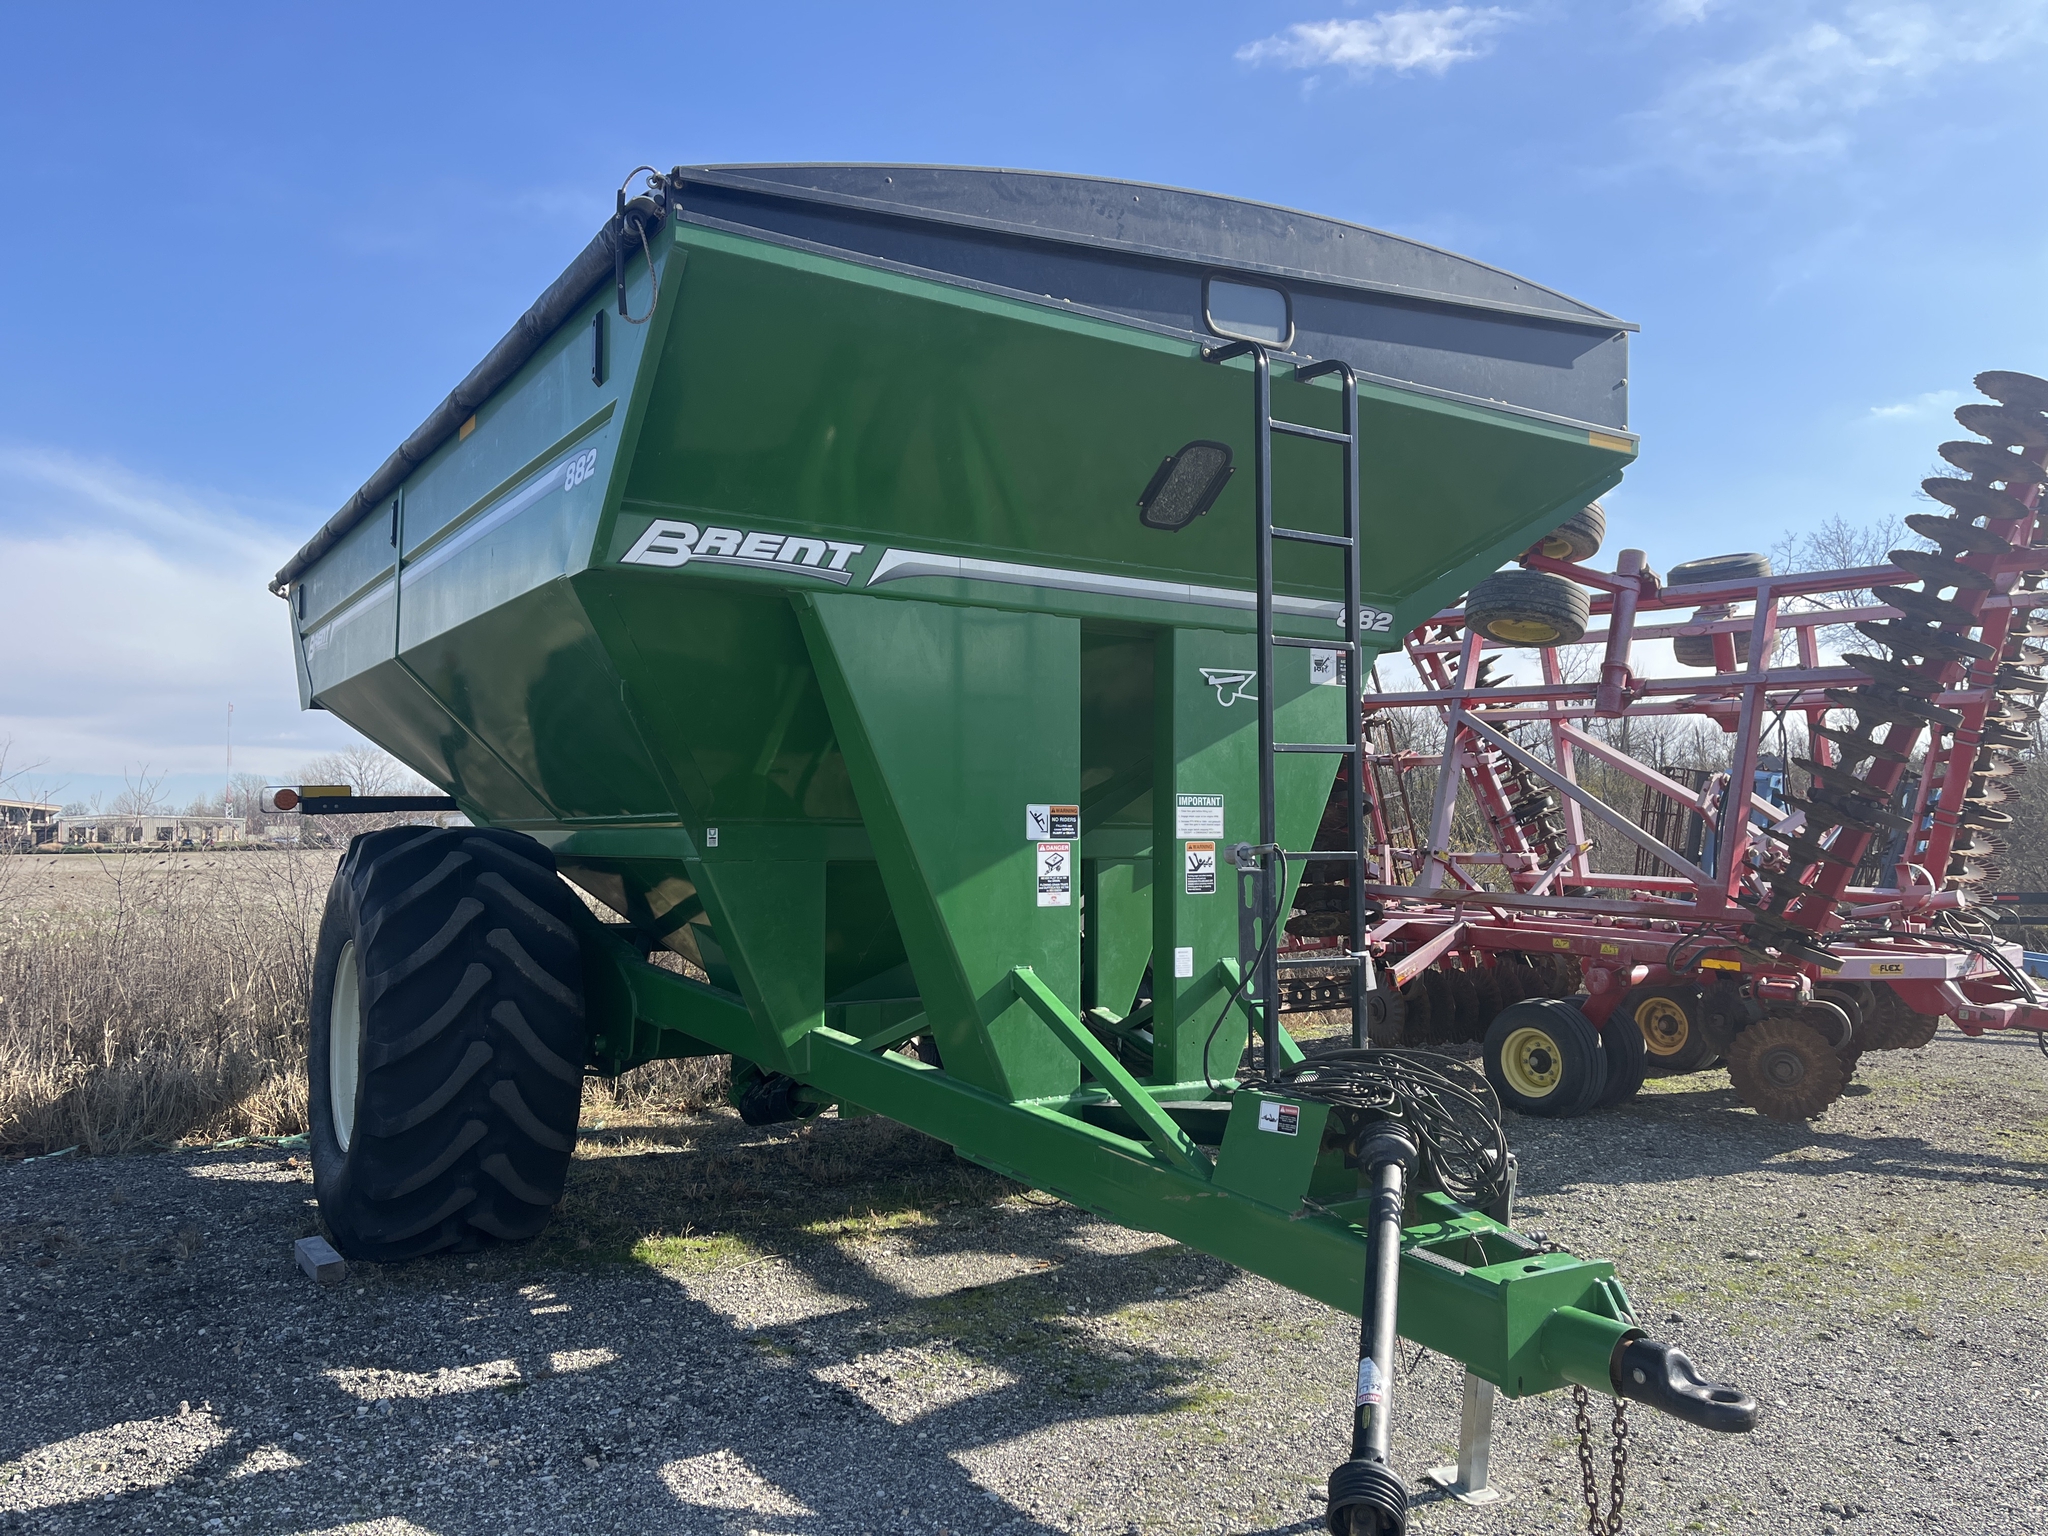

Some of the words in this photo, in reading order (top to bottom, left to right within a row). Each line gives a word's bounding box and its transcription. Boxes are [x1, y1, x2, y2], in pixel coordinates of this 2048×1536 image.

[564, 447, 597, 491] 882
[620, 519, 865, 571] BRENT
[1179, 796, 1221, 806] IMPORTANT
[1880, 964, 1902, 972] FLEX
